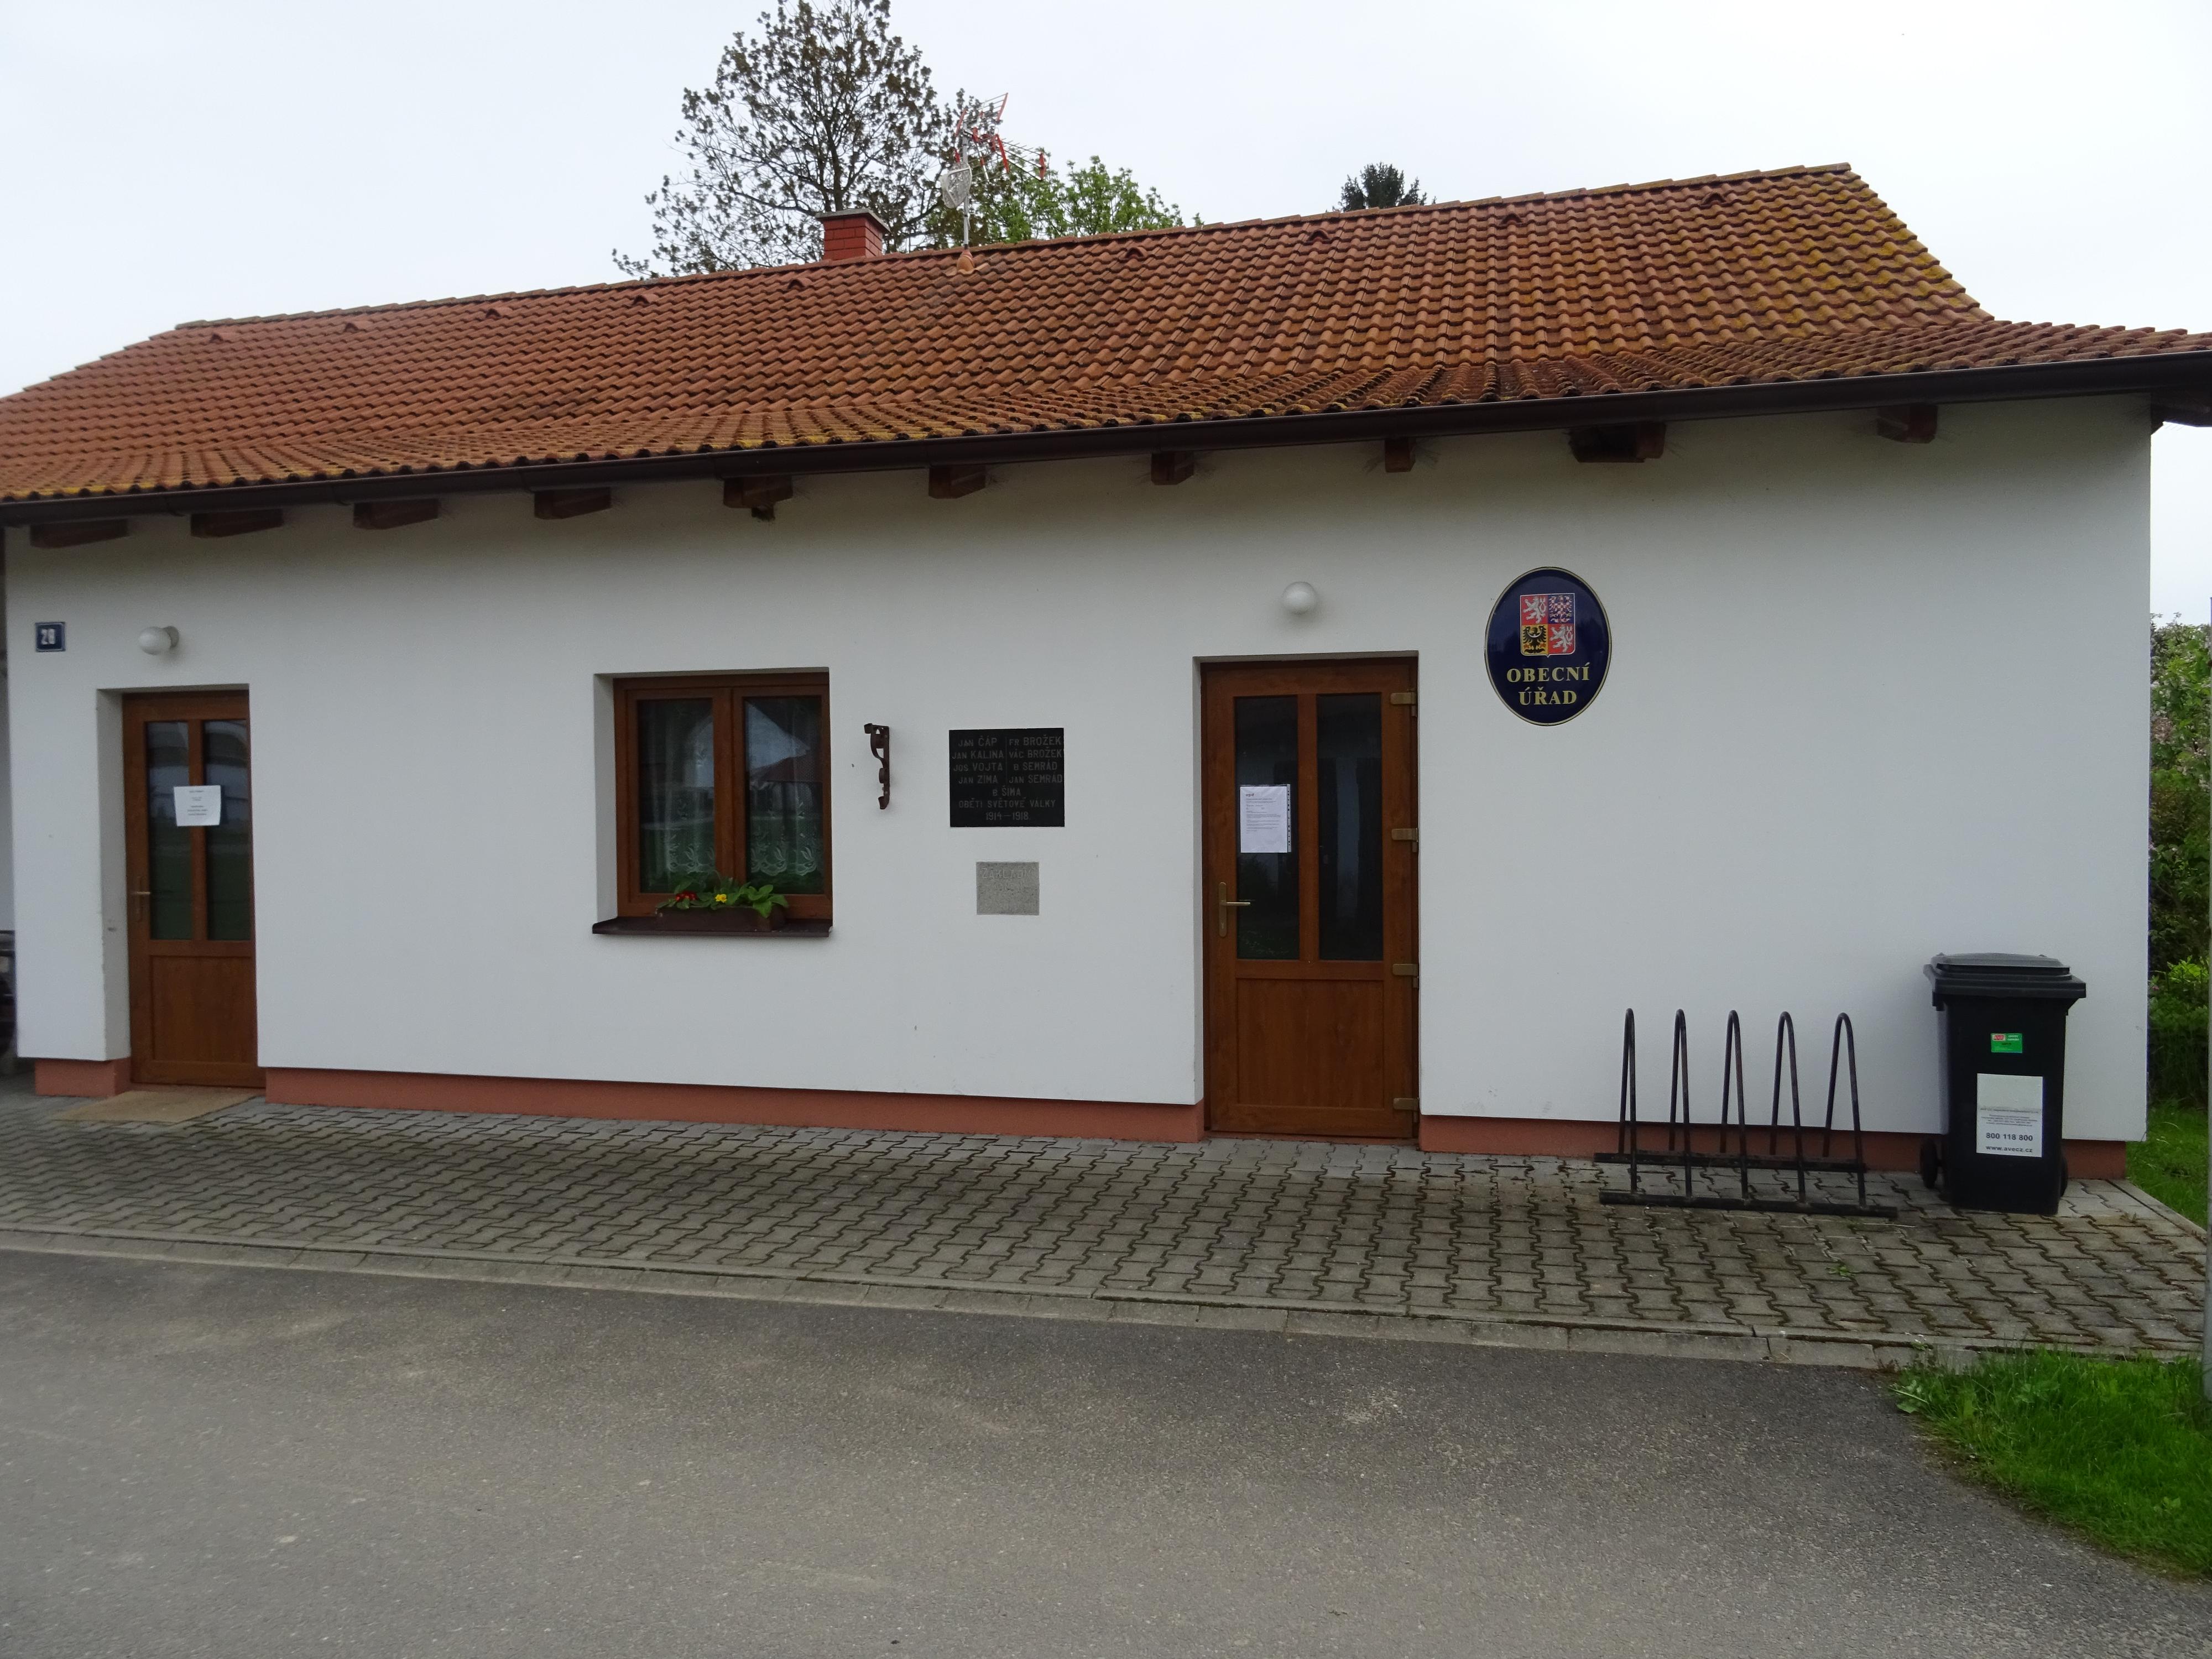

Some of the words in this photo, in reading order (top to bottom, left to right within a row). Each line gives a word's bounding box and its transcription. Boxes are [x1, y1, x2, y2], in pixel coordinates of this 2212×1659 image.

[1506, 662, 1590, 682] OBECNÍ
[1519, 686, 1577, 705] ÚŘAD
[978, 735, 997, 747] ČÁP
[1024, 734, 1061, 746] BROŽEK
[971, 750, 1004, 759] KALINA
[1027, 747, 1062, 758] BROŽEK
[972, 763, 1003, 771] VOJTA
[1023, 759, 1057, 770] SEMRÁD
[1029, 771, 1063, 784] SEMRÁD
[988, 797, 1025, 808] SVĚTOVÉ
